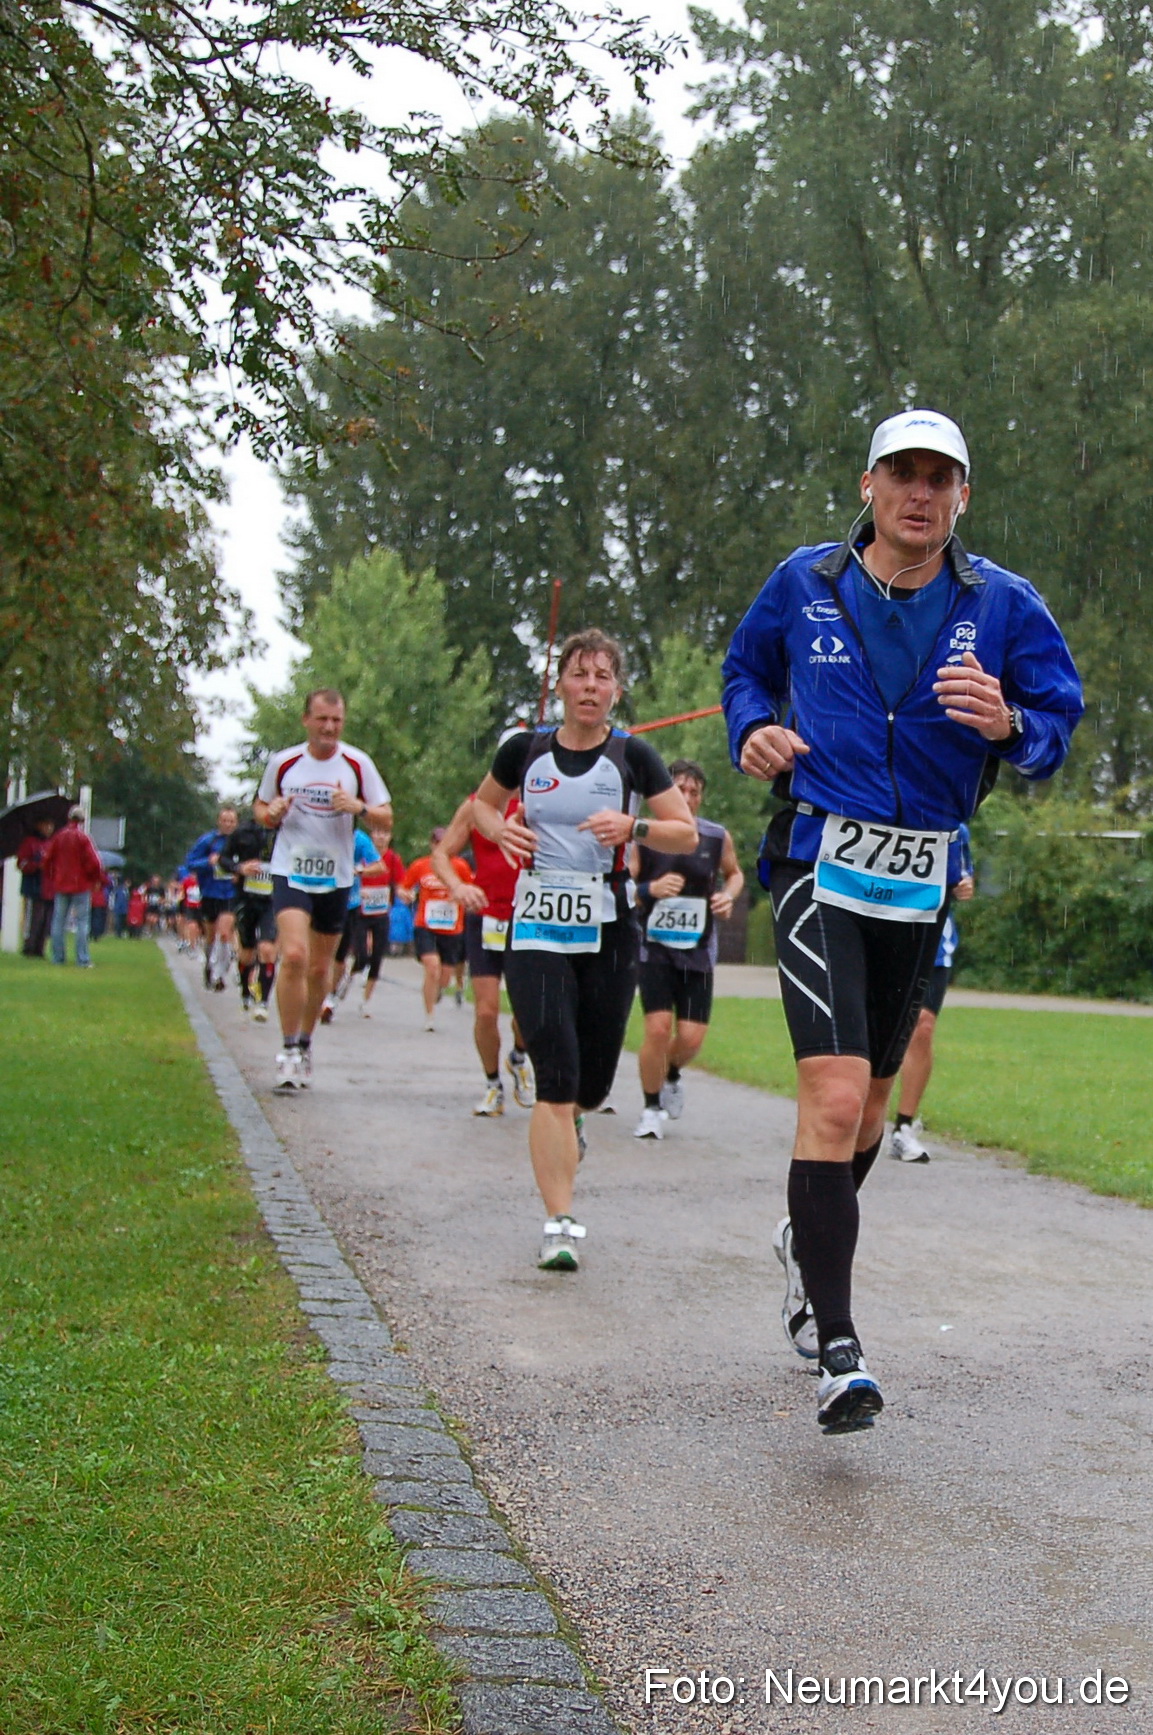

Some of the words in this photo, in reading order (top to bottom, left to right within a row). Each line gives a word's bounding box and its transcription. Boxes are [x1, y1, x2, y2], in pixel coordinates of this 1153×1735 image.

[834, 820, 938, 879] 2755
[294, 857, 335, 876] 3090
[863, 882, 894, 901] Jan
[521, 891, 592, 924] 2505
[655, 911, 698, 930] 2544
